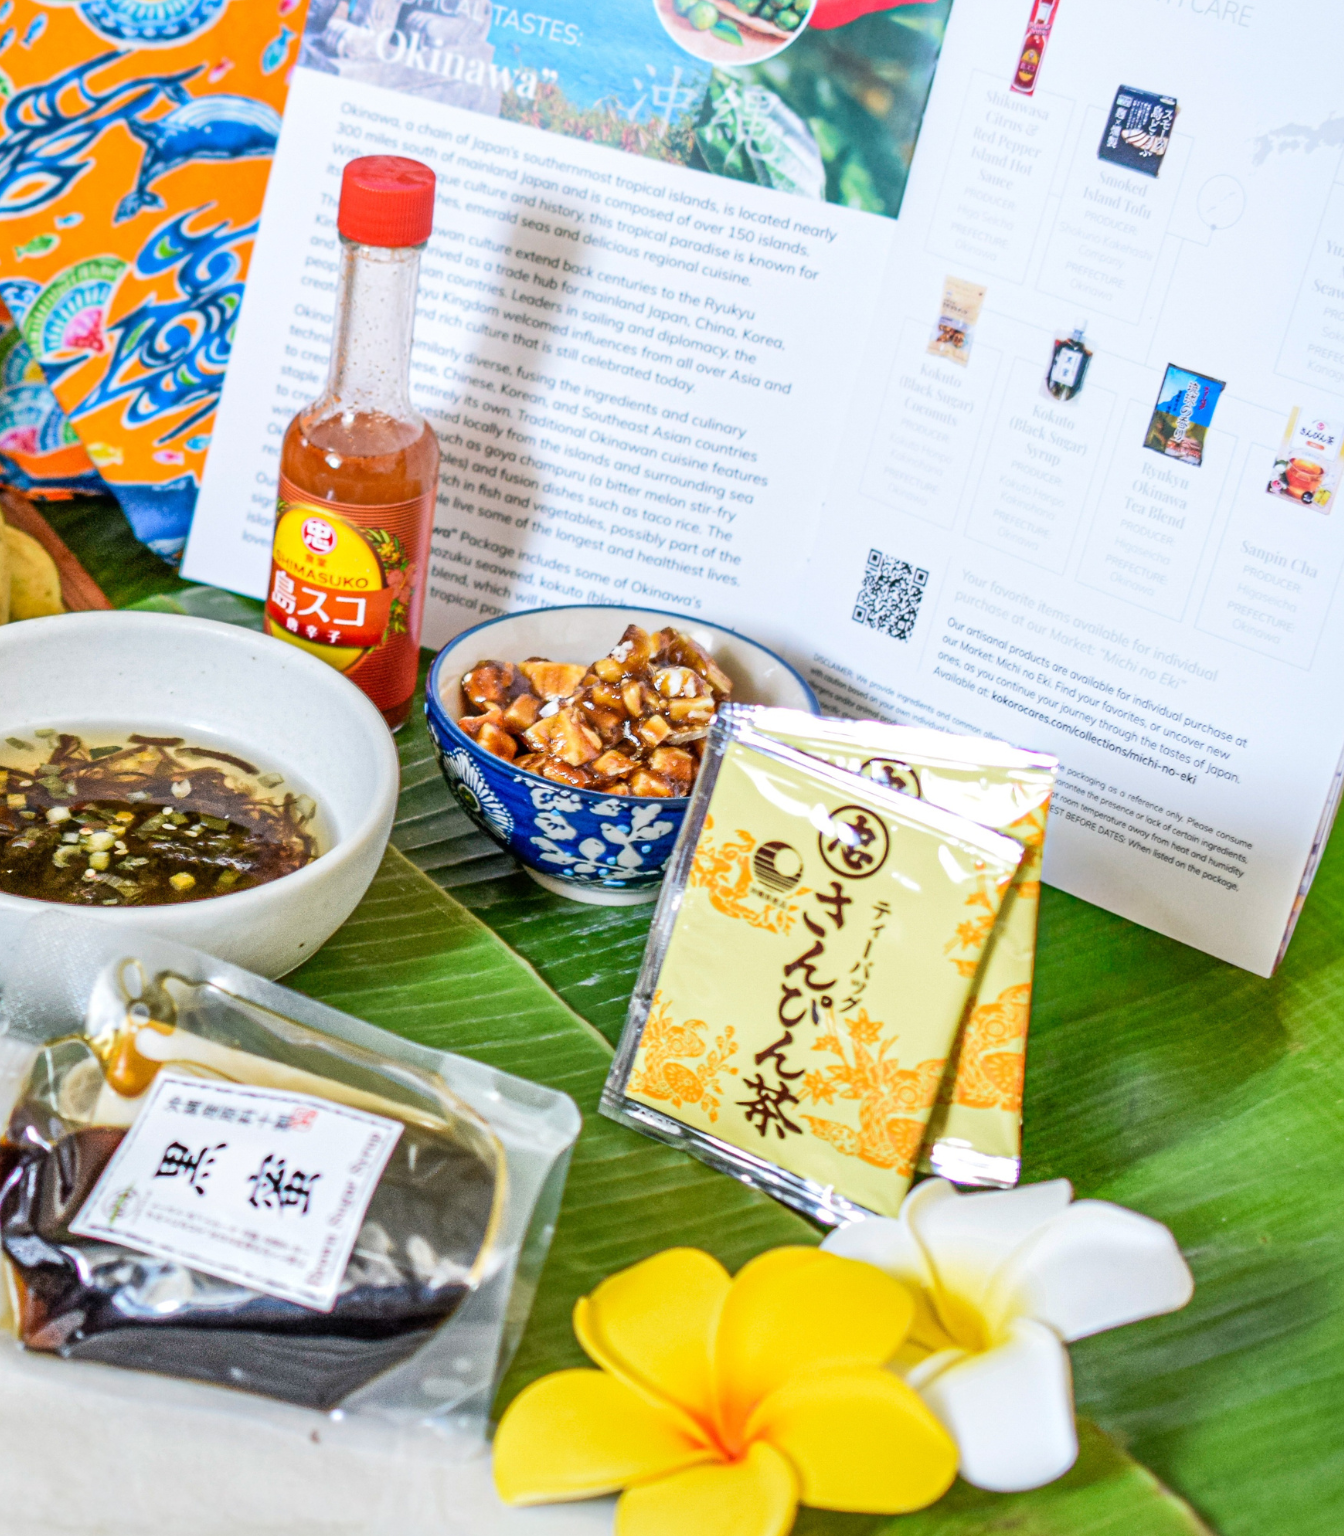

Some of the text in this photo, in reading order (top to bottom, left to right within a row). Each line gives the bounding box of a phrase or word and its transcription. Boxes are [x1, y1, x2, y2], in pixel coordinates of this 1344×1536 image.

[491, 7, 584, 48] TASTES:
[609, 64, 796, 160] 沖縄
[986, 90, 1047, 120] Shikuwasa
[987, 110, 1021, 132] Citrus
[973, 146, 1030, 176] Island Hot
[975, 127, 1039, 158] Red Pepper
[337, 120, 809, 257] 300 miles south of mainland Japan and is composed of over 150 islands.
[341, 101, 401, 130] Okinawa,
[418, 123, 452, 142] chain
[457, 133, 468, 146] of
[472, 135, 519, 159] Japan's
[524, 152, 612, 184] southernmost
[617, 174, 665, 197] tropical
[670, 187, 719, 213] islands,
[725, 201, 734, 215] is
[740, 205, 790, 229] located
[794, 222, 836, 245] nearly
[980, 168, 1011, 190] Sauce
[1100, 171, 1146, 197] Smoked
[1085, 186, 1149, 219] Island Tofu
[922, 363, 960, 388] Kokuto
[444, 366, 495, 394] Chinese,
[501, 382, 548, 409] Korean,
[554, 399, 577, 415] and
[582, 404, 649, 434] Southeast
[653, 423, 691, 445] Asian
[696, 438, 757, 463] countries
[906, 396, 956, 426] Coconuts
[1034, 405, 1073, 430] Kokuto
[415, 381, 768, 486] entirely its own. Traditional Okinawan cuisine features
[1027, 442, 1059, 468] Syrup
[1143, 461, 1187, 489] Ryukyu
[1125, 496, 1183, 529] Tea Blend
[1134, 479, 1185, 509] Okinawa
[454, 496, 739, 587] live some of the longest and healthiest lives.
[1240, 538, 1320, 579] Sanpin Cha
[275, 550, 369, 590] SHIMASUKO
[271, 570, 367, 627] 島スコ
[955, 592, 1007, 619] purchase
[1012, 615, 1024, 626] at
[1028, 622, 1045, 635] our
[1141, 667, 1155, 679] no
[961, 569, 1217, 680] Your favorite items available for individual
[943, 635, 1229, 760] our Market: Michi no Eki. Find your favorites, or uncover new
[948, 616, 1248, 747] Our artisanal products are available for individual purchase at
[934, 665, 974, 691] Available
[978, 687, 990, 697] at:
[992, 690, 1196, 784] kokorocares.com/collections/michi-no-eki
[939, 651, 1239, 783] ones, as you continue your journey through the tastes of Japan.
[1067, 768, 1105, 791] packaging
[1109, 785, 1117, 794] as
[1129, 793, 1162, 813] reference
[1188, 815, 1213, 833] Please
[1217, 830, 1251, 849] consume
[735, 881, 853, 1139] さんぴん茶
[153, 1141, 322, 1215] 黒蜜
